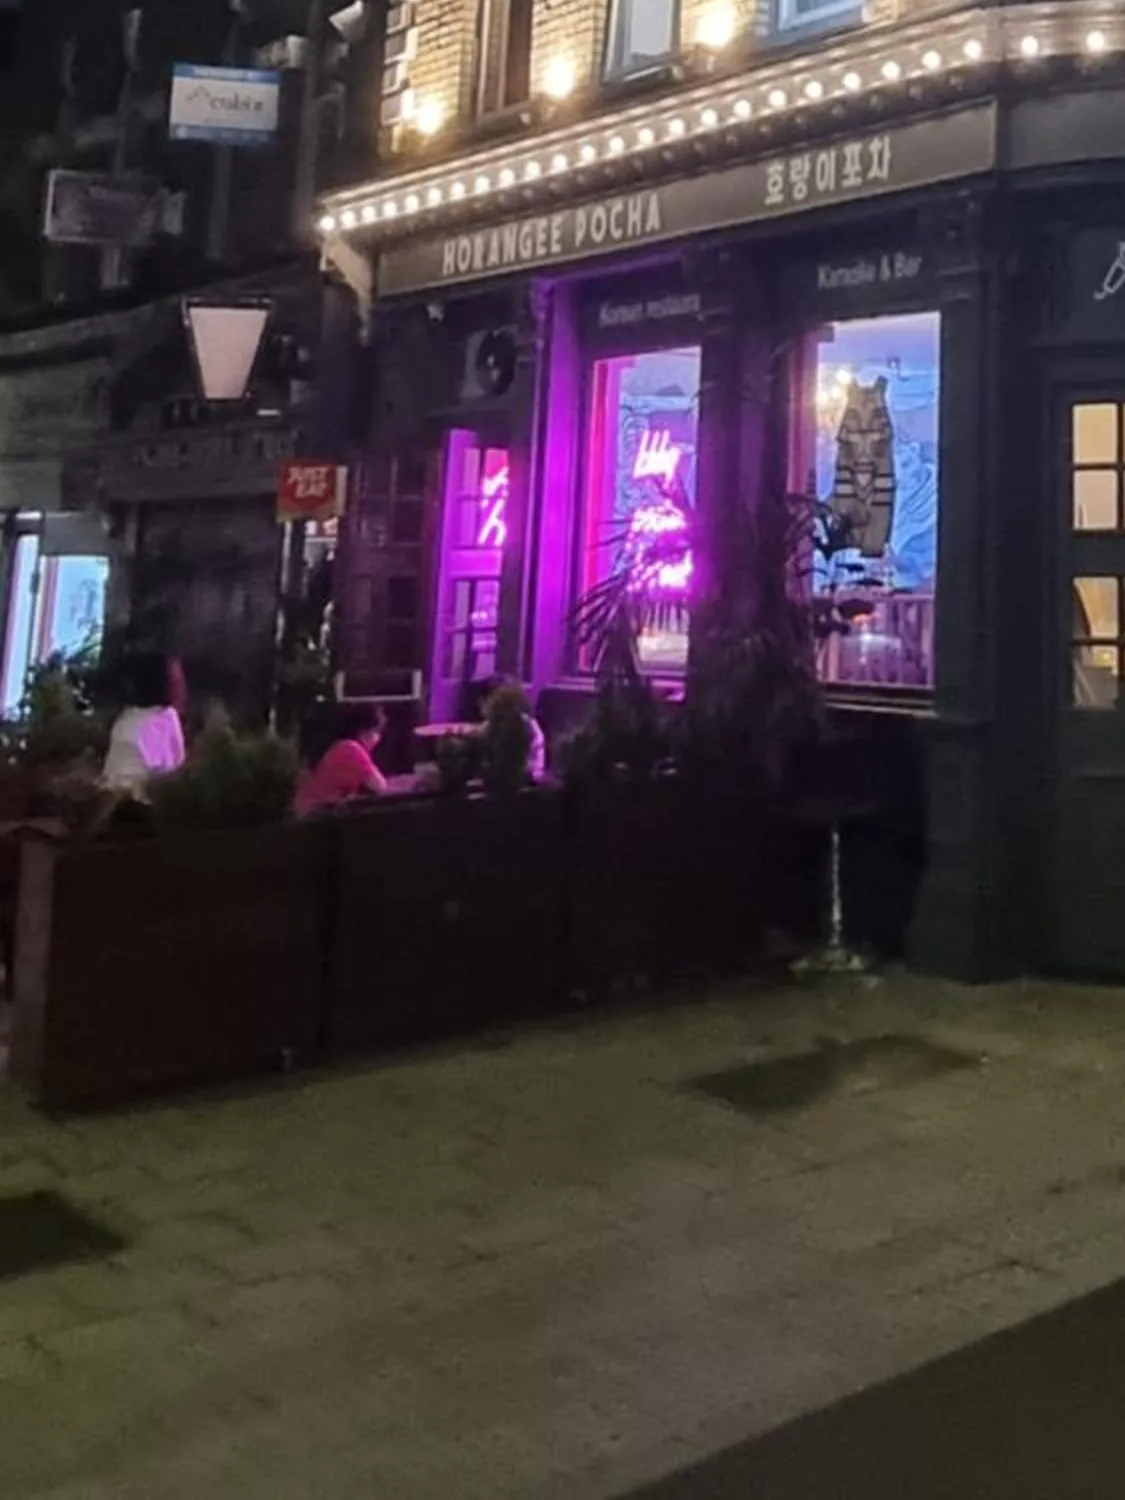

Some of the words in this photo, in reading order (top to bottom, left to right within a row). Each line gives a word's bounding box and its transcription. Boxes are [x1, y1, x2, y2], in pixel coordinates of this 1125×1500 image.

[764, 138, 893, 205] 호랑이포차
[441, 214, 564, 276] HORANGEE
[573, 193, 662, 247] POCHA
[894, 251, 922, 279] Bar
[287, 466, 330, 484] JUST
[295, 479, 328, 498] EAT
